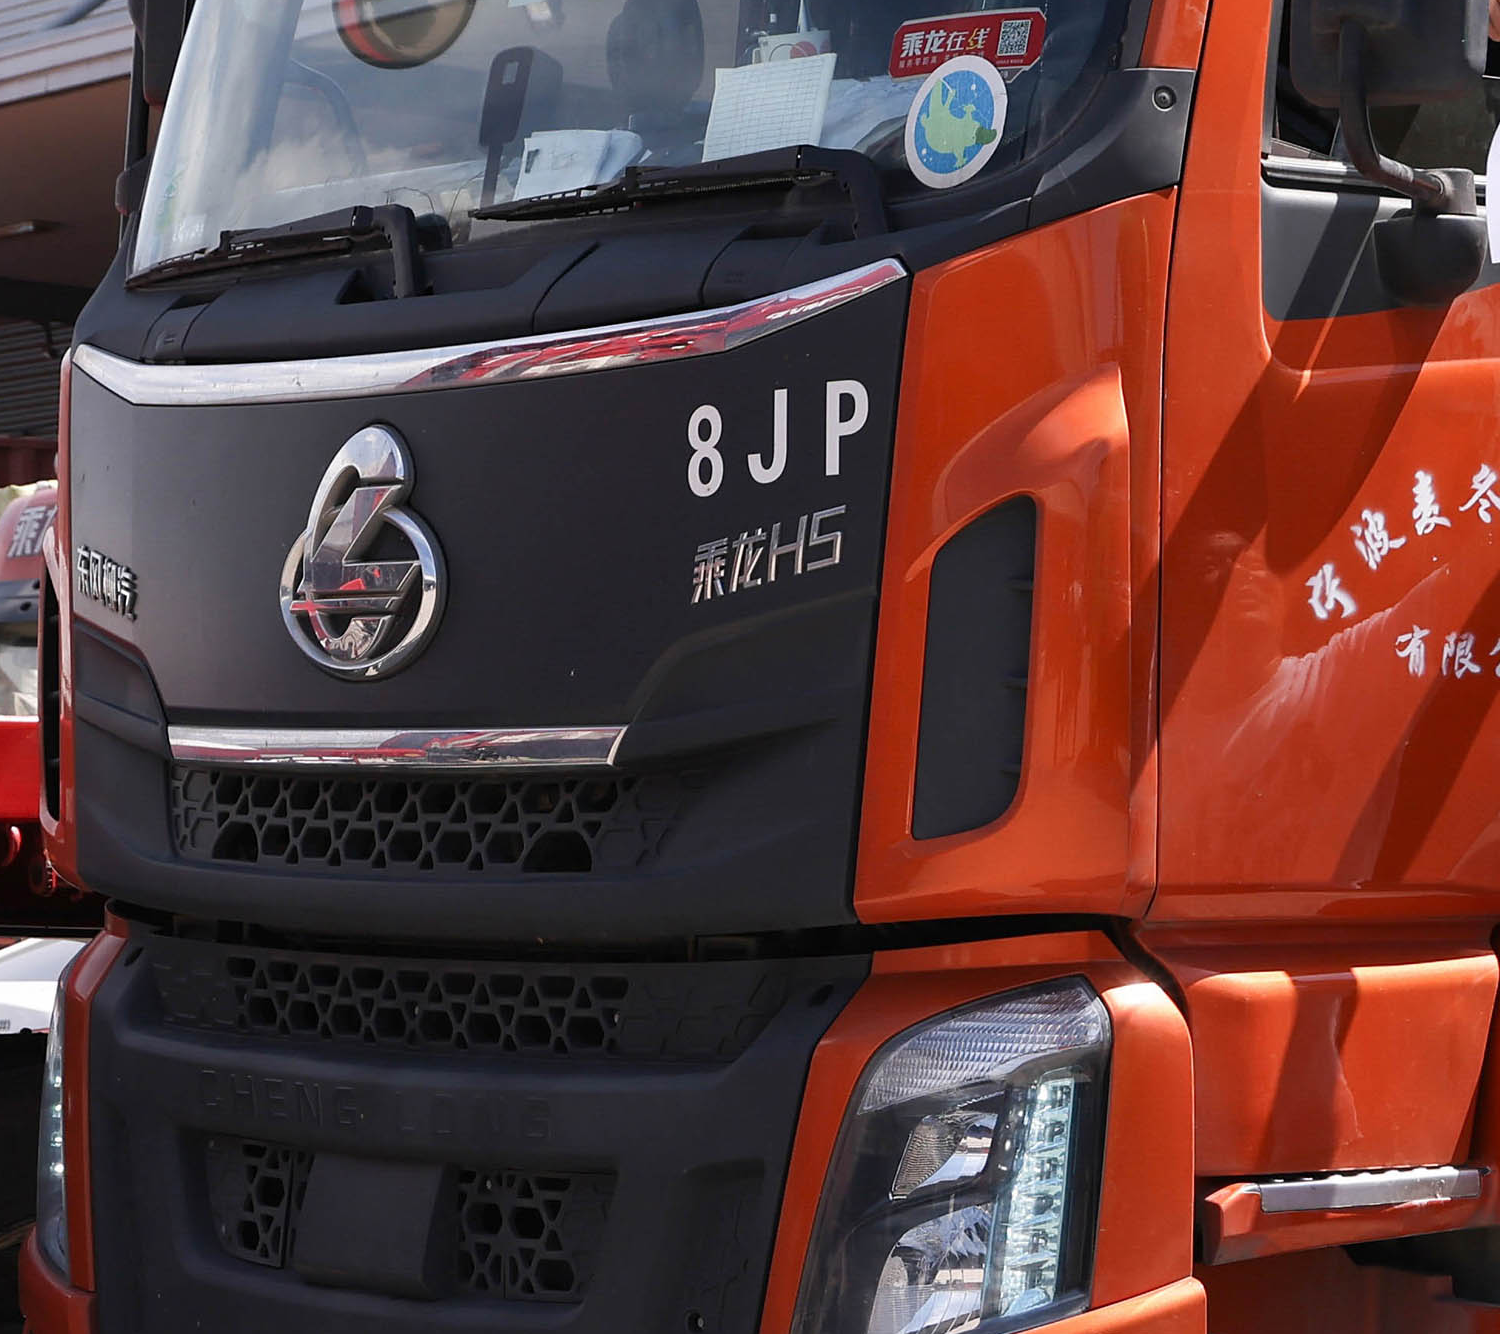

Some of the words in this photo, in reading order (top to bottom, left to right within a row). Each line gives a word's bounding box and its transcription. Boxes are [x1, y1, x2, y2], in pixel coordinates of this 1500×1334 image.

[900, 27, 991, 58] 乘龙在线
[691, 504, 847, 605] 乘龙H5
